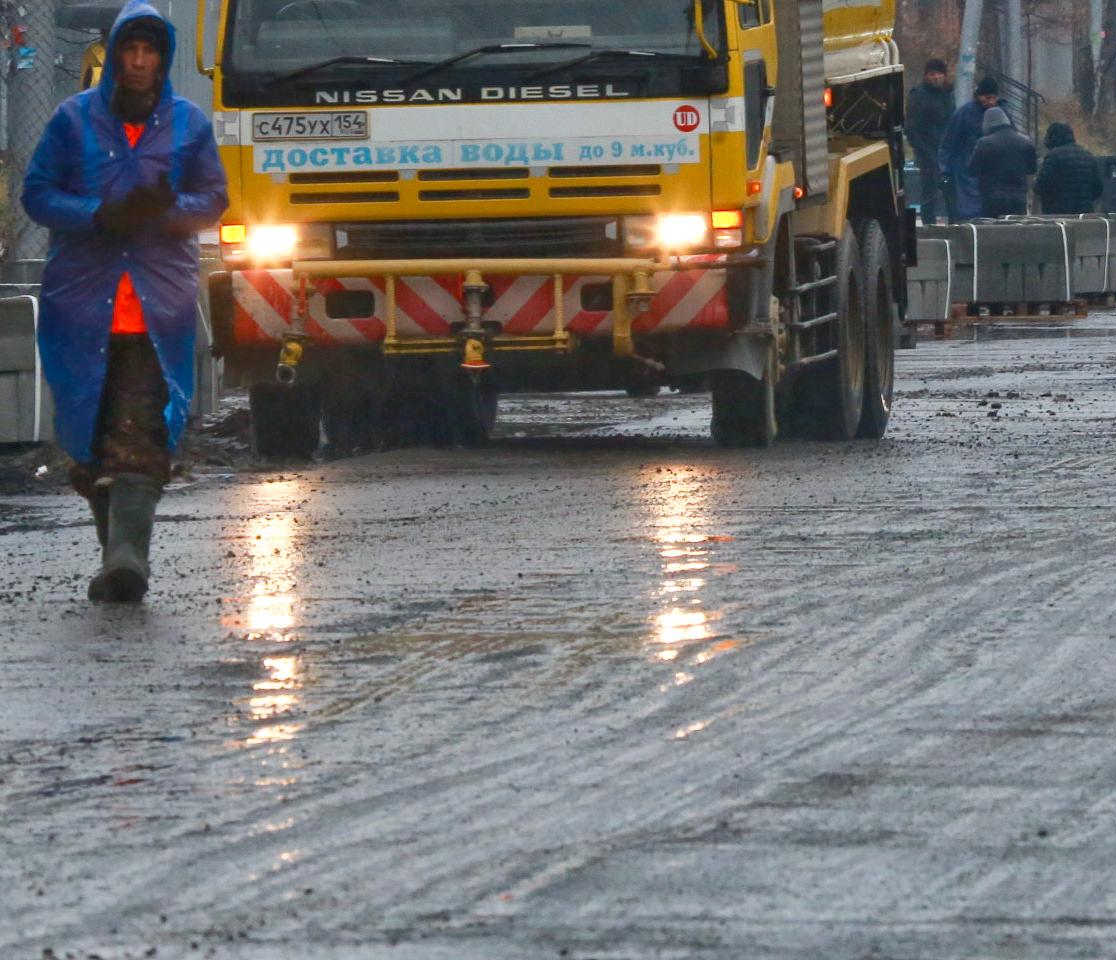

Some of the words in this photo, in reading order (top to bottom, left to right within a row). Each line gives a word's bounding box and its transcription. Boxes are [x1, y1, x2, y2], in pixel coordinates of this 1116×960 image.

[315, 88, 462, 104] NISSAN
[480, 84, 630, 100] DIESEL
[674, 111, 699, 127] UD
[261, 144, 443, 172] доставка
[460, 142, 565, 165] воды
[578, 145, 605, 161] до
[611, 140, 624, 158] 9
